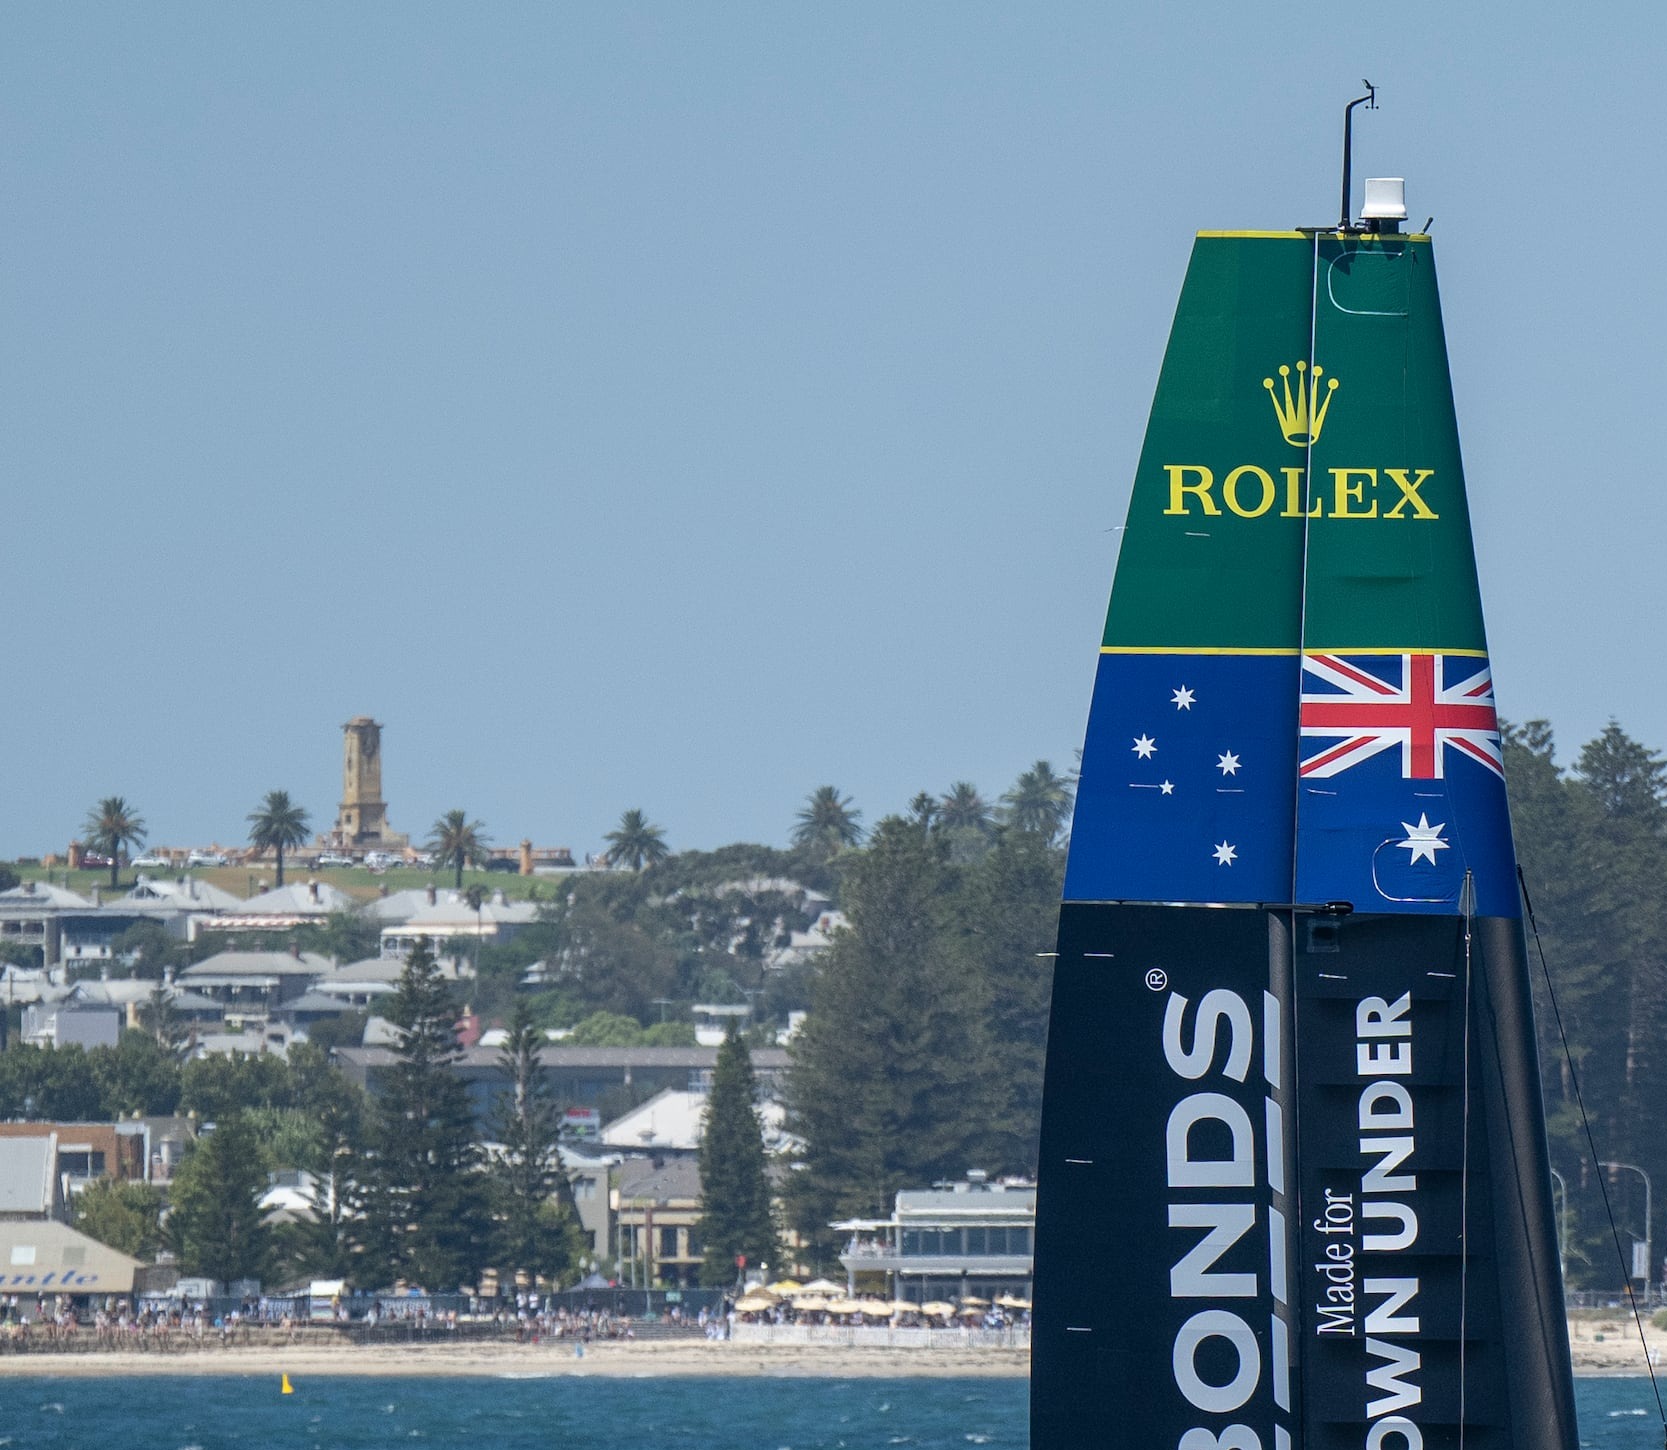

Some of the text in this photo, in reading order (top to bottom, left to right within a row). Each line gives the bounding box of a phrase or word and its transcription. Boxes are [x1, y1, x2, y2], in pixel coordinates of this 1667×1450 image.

[1163, 465, 1439, 520] ROLEX
[1356, 990, 1418, 1251] UNDER
[0, 1270, 98, 1286] ntle
[1313, 1187, 1355, 1337] Made for
